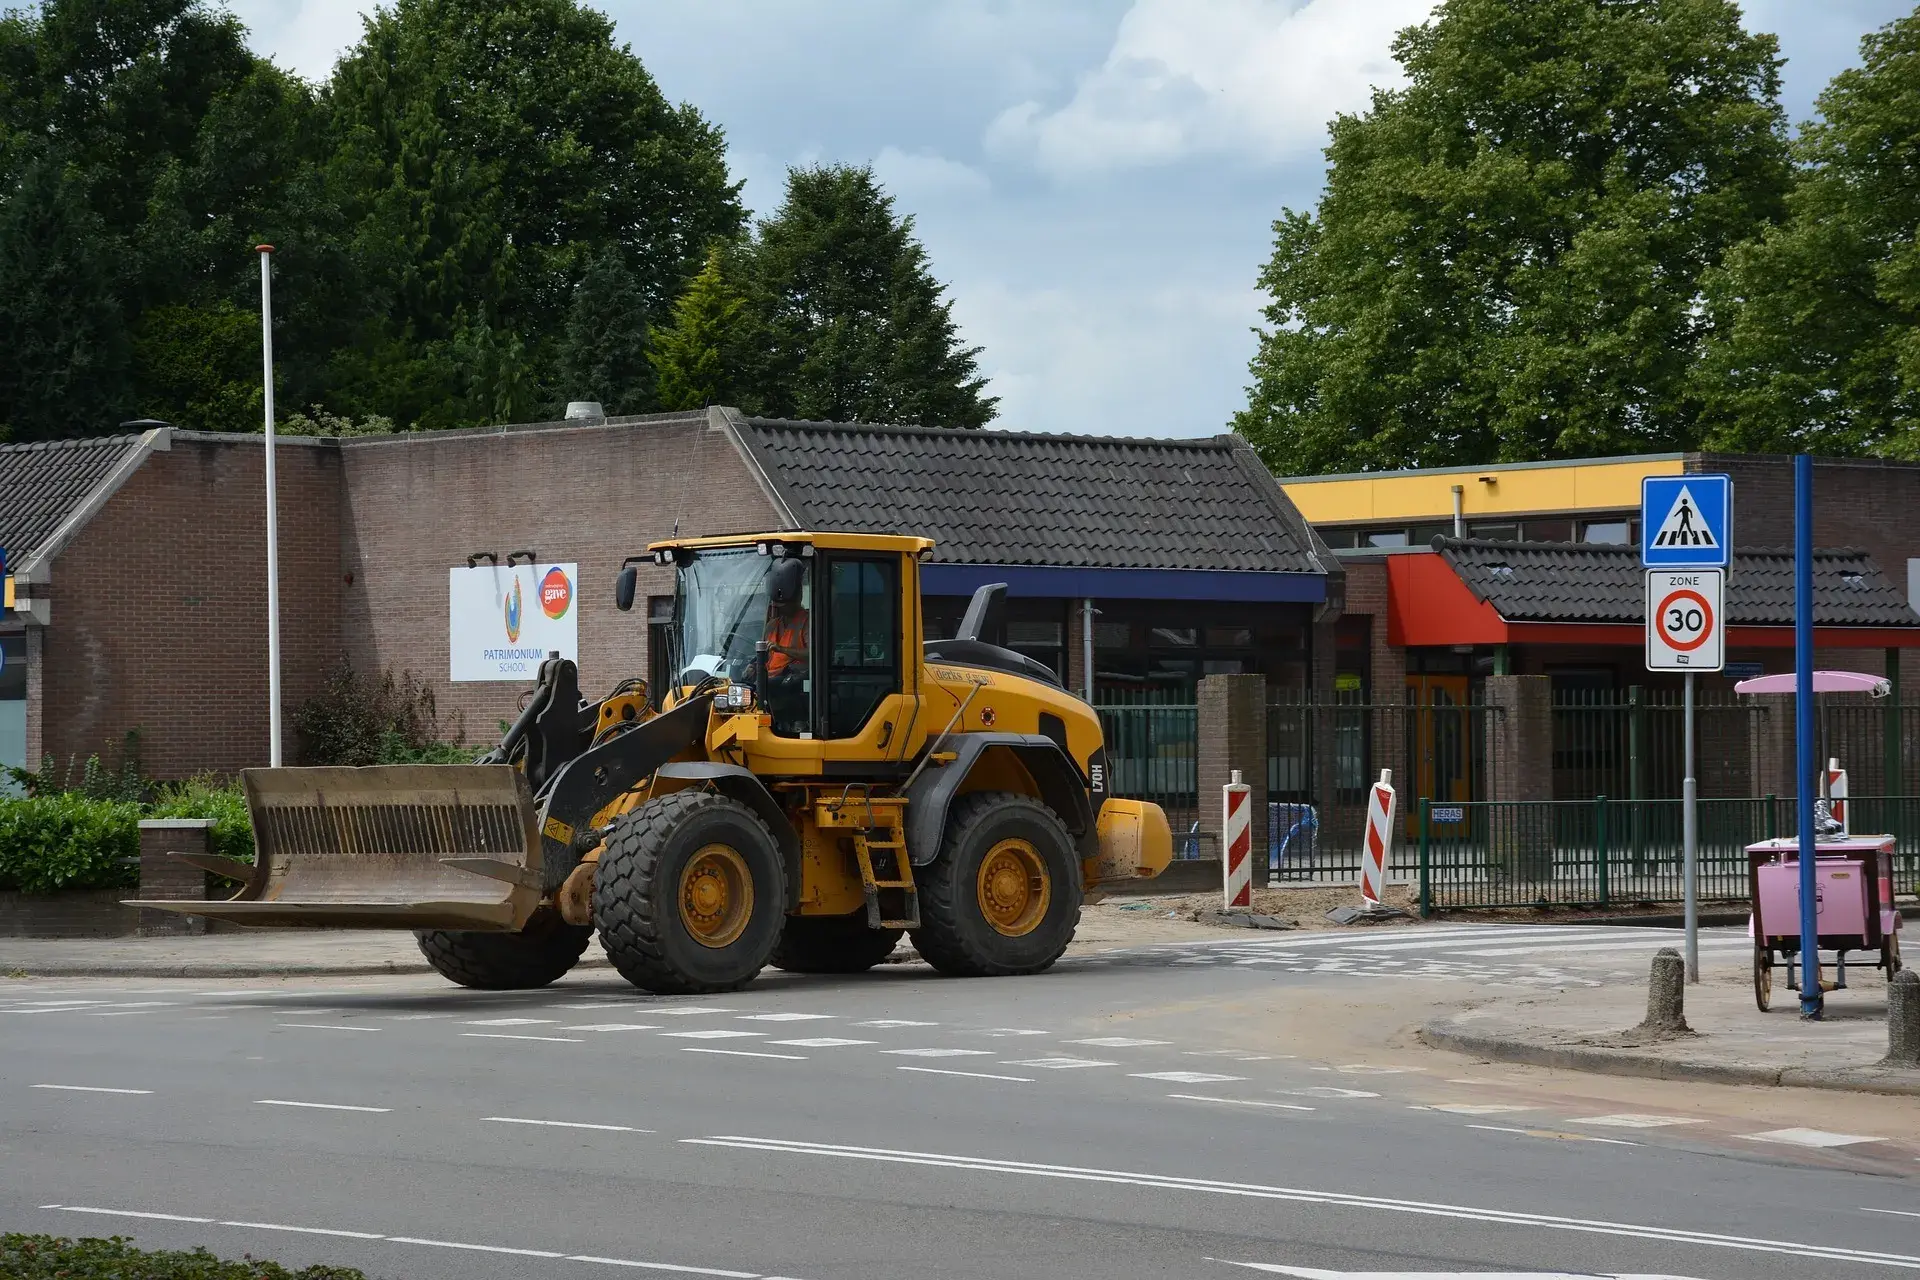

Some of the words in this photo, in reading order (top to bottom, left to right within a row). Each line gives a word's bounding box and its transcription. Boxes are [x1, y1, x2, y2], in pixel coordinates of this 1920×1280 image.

[1669, 576, 1700, 586] ZONE
[544, 588, 567, 604] gave
[1667, 608, 1703, 632] 30
[483, 648, 543, 660] PATRIMONIUM
[499, 662, 527, 672] SCHOOL
[935, 667, 963, 681] derks
[1091, 764, 1104, 793] L70H
[1434, 808, 1462, 818] HERAS
